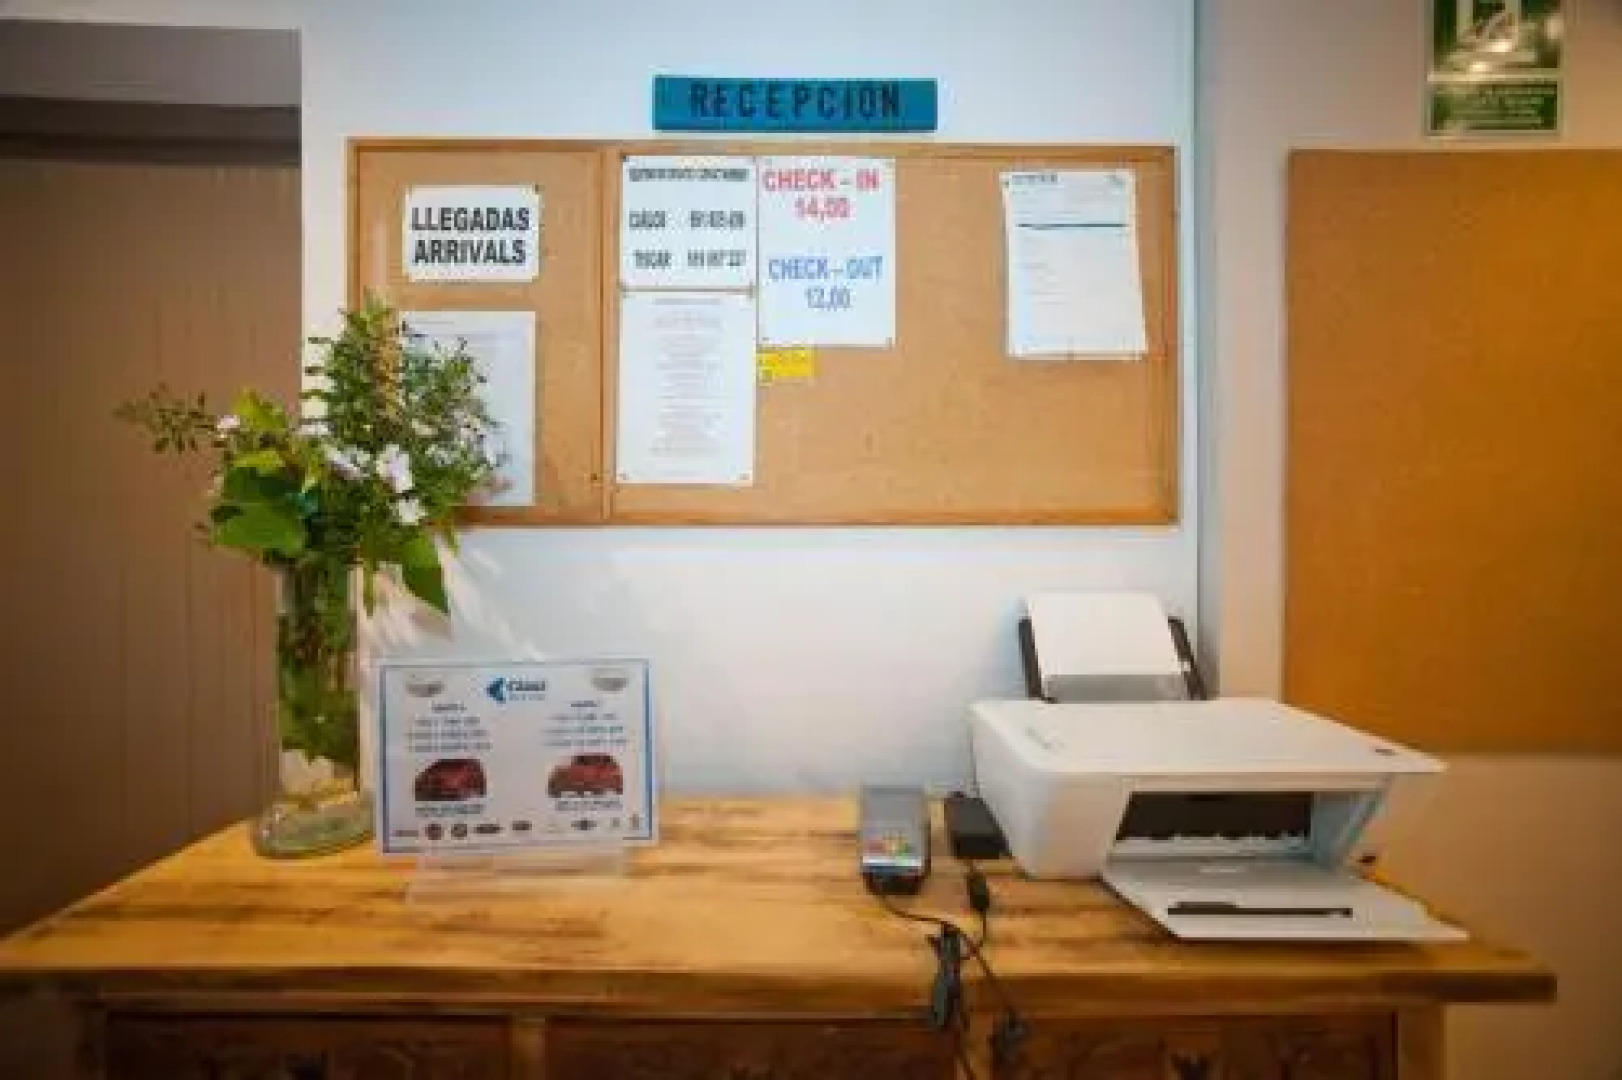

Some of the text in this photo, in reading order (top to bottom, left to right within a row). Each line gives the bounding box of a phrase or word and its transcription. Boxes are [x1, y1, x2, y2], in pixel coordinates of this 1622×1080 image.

[763, 168, 836, 192] CHECK
[411, 207, 530, 231] LLEGADAS
[412, 239, 527, 264] ARRIVALS
[767, 257, 829, 282] CHECK
[845, 255, 883, 281] OUT
